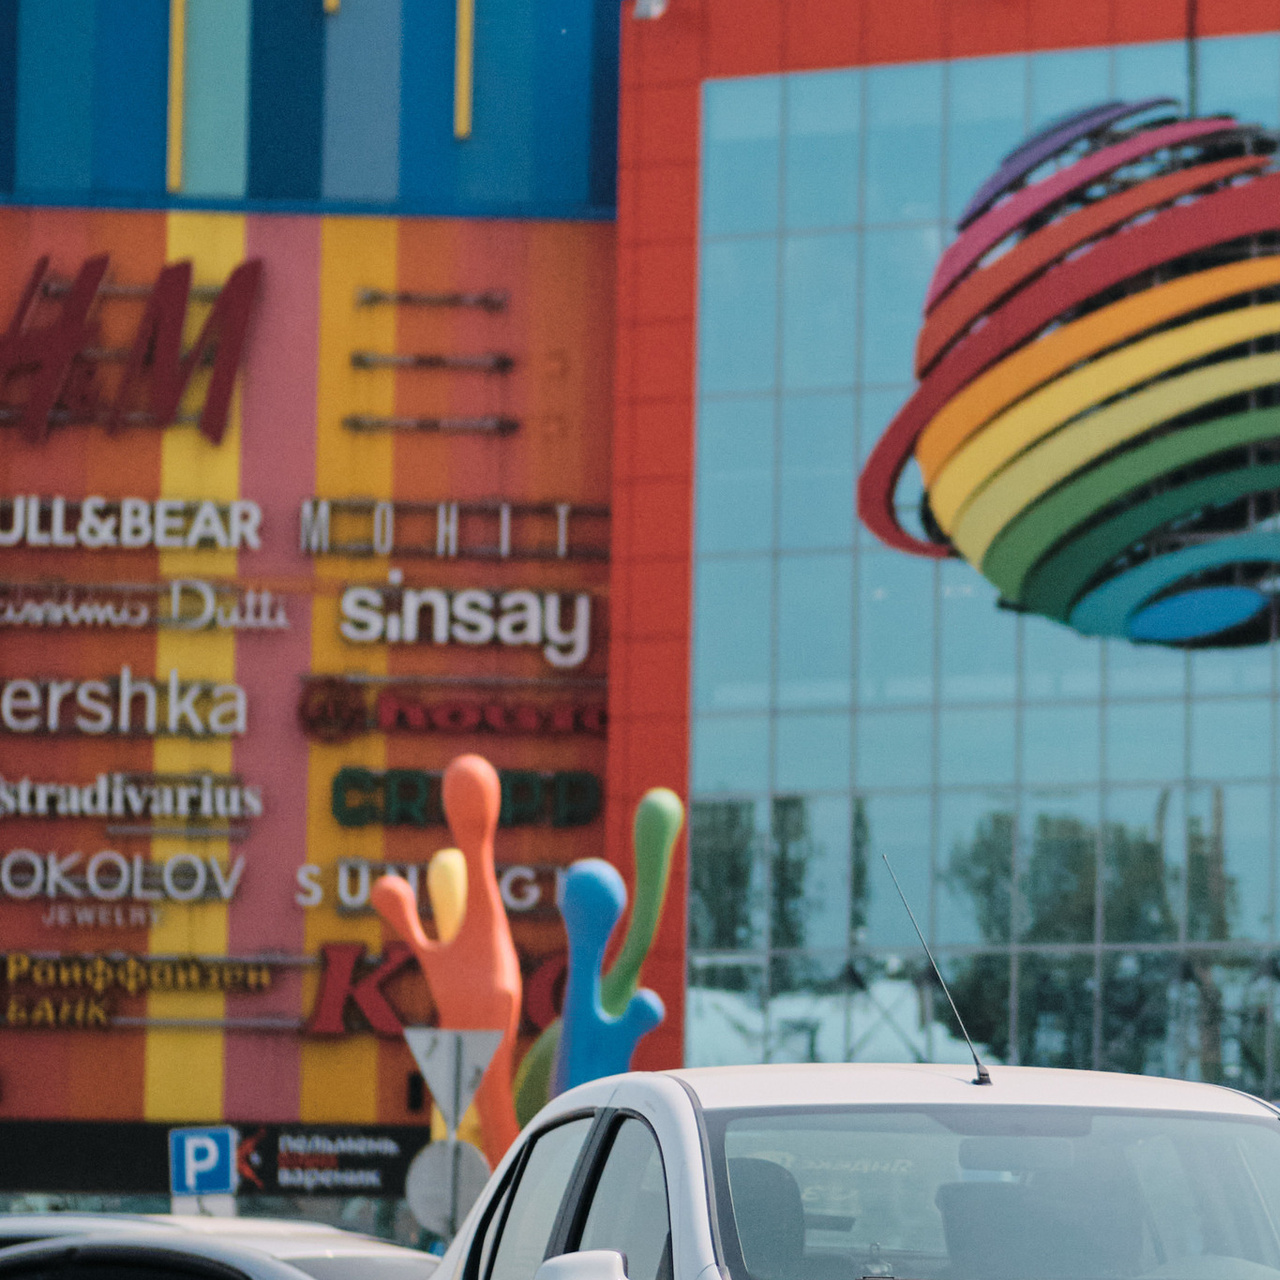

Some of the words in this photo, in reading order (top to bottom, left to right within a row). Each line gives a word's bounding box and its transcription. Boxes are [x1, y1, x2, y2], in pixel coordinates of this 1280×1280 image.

[340, 568, 592, 667] sinsay
[1, 665, 247, 733] ershka
[332, 767, 604, 827] CRPP
[0, 848, 246, 901] OKOLOV
